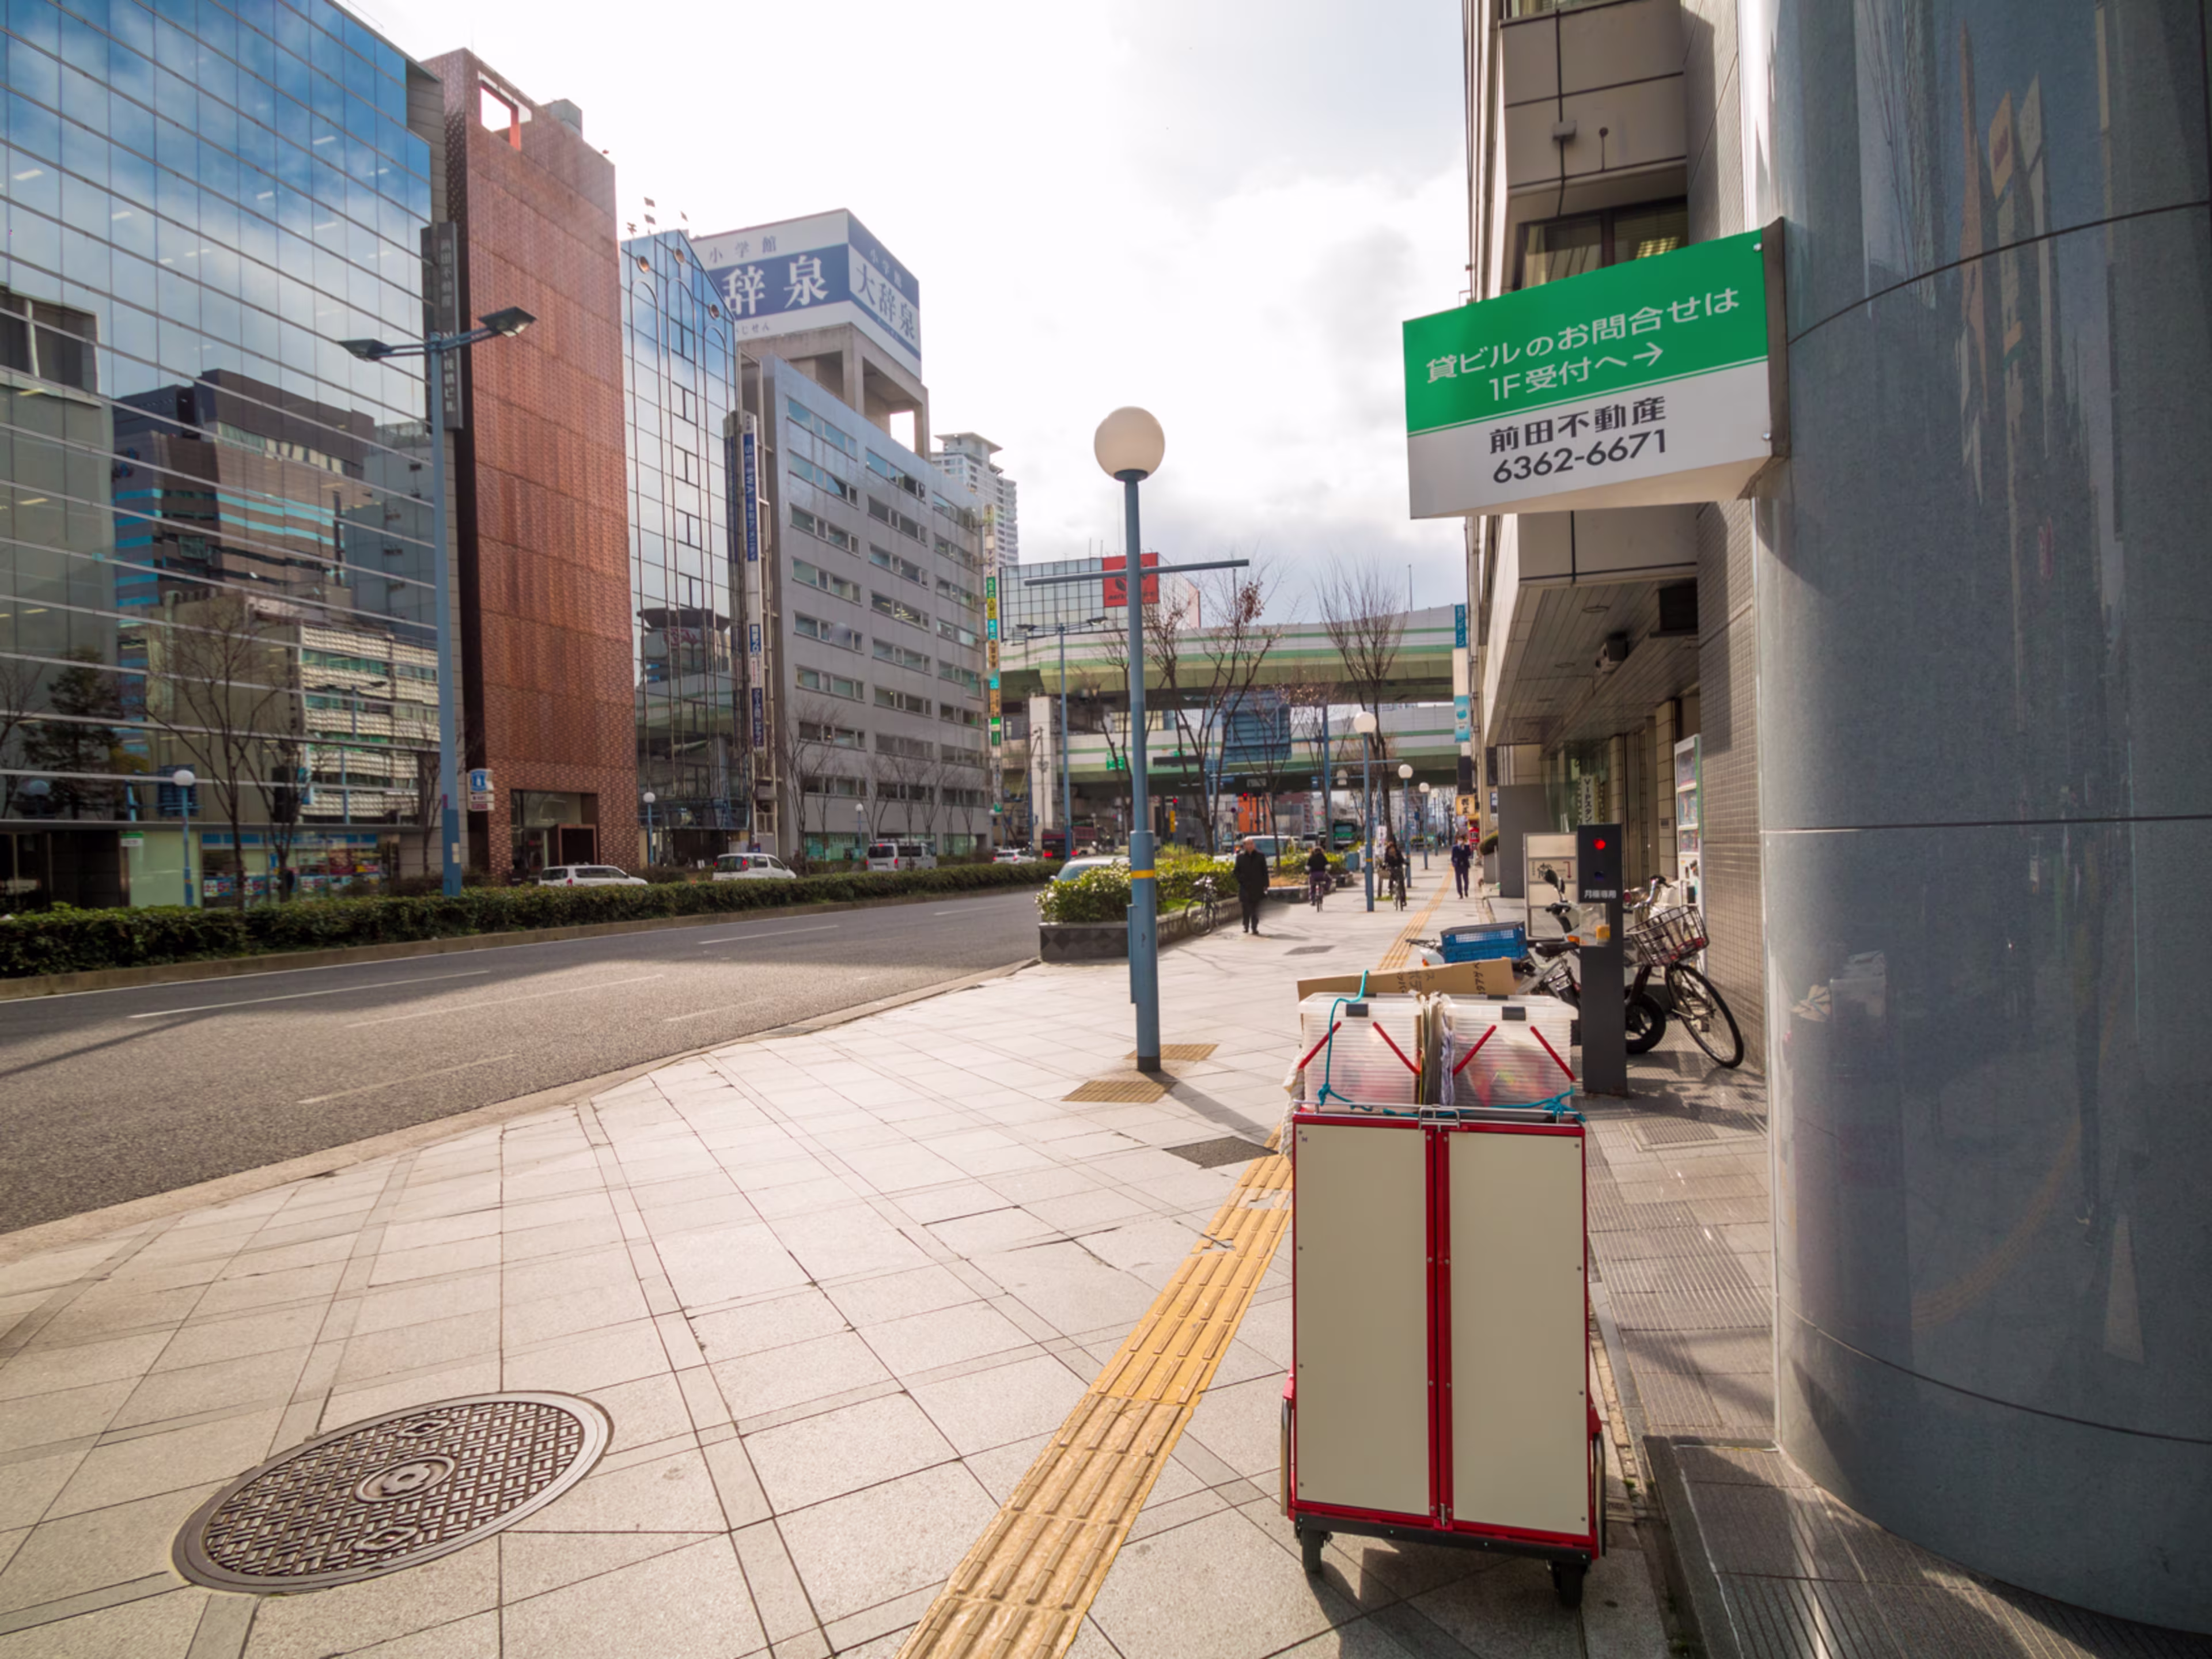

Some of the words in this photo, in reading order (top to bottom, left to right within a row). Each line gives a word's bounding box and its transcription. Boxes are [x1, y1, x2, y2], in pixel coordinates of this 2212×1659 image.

[710, 235, 777, 263] 小学館
[856, 263, 915, 340] 大辞泉
[736, 323, 770, 335] じせん
[1426, 287, 1740, 384] 貸ビルのお問合せは
[1488, 355, 1628, 401] 1F受付へ
[1489, 396, 1666, 454] 前田不動産
[1493, 428, 1666, 484] 6362-6671
[1584, 778, 1592, 824] VIPスタン
